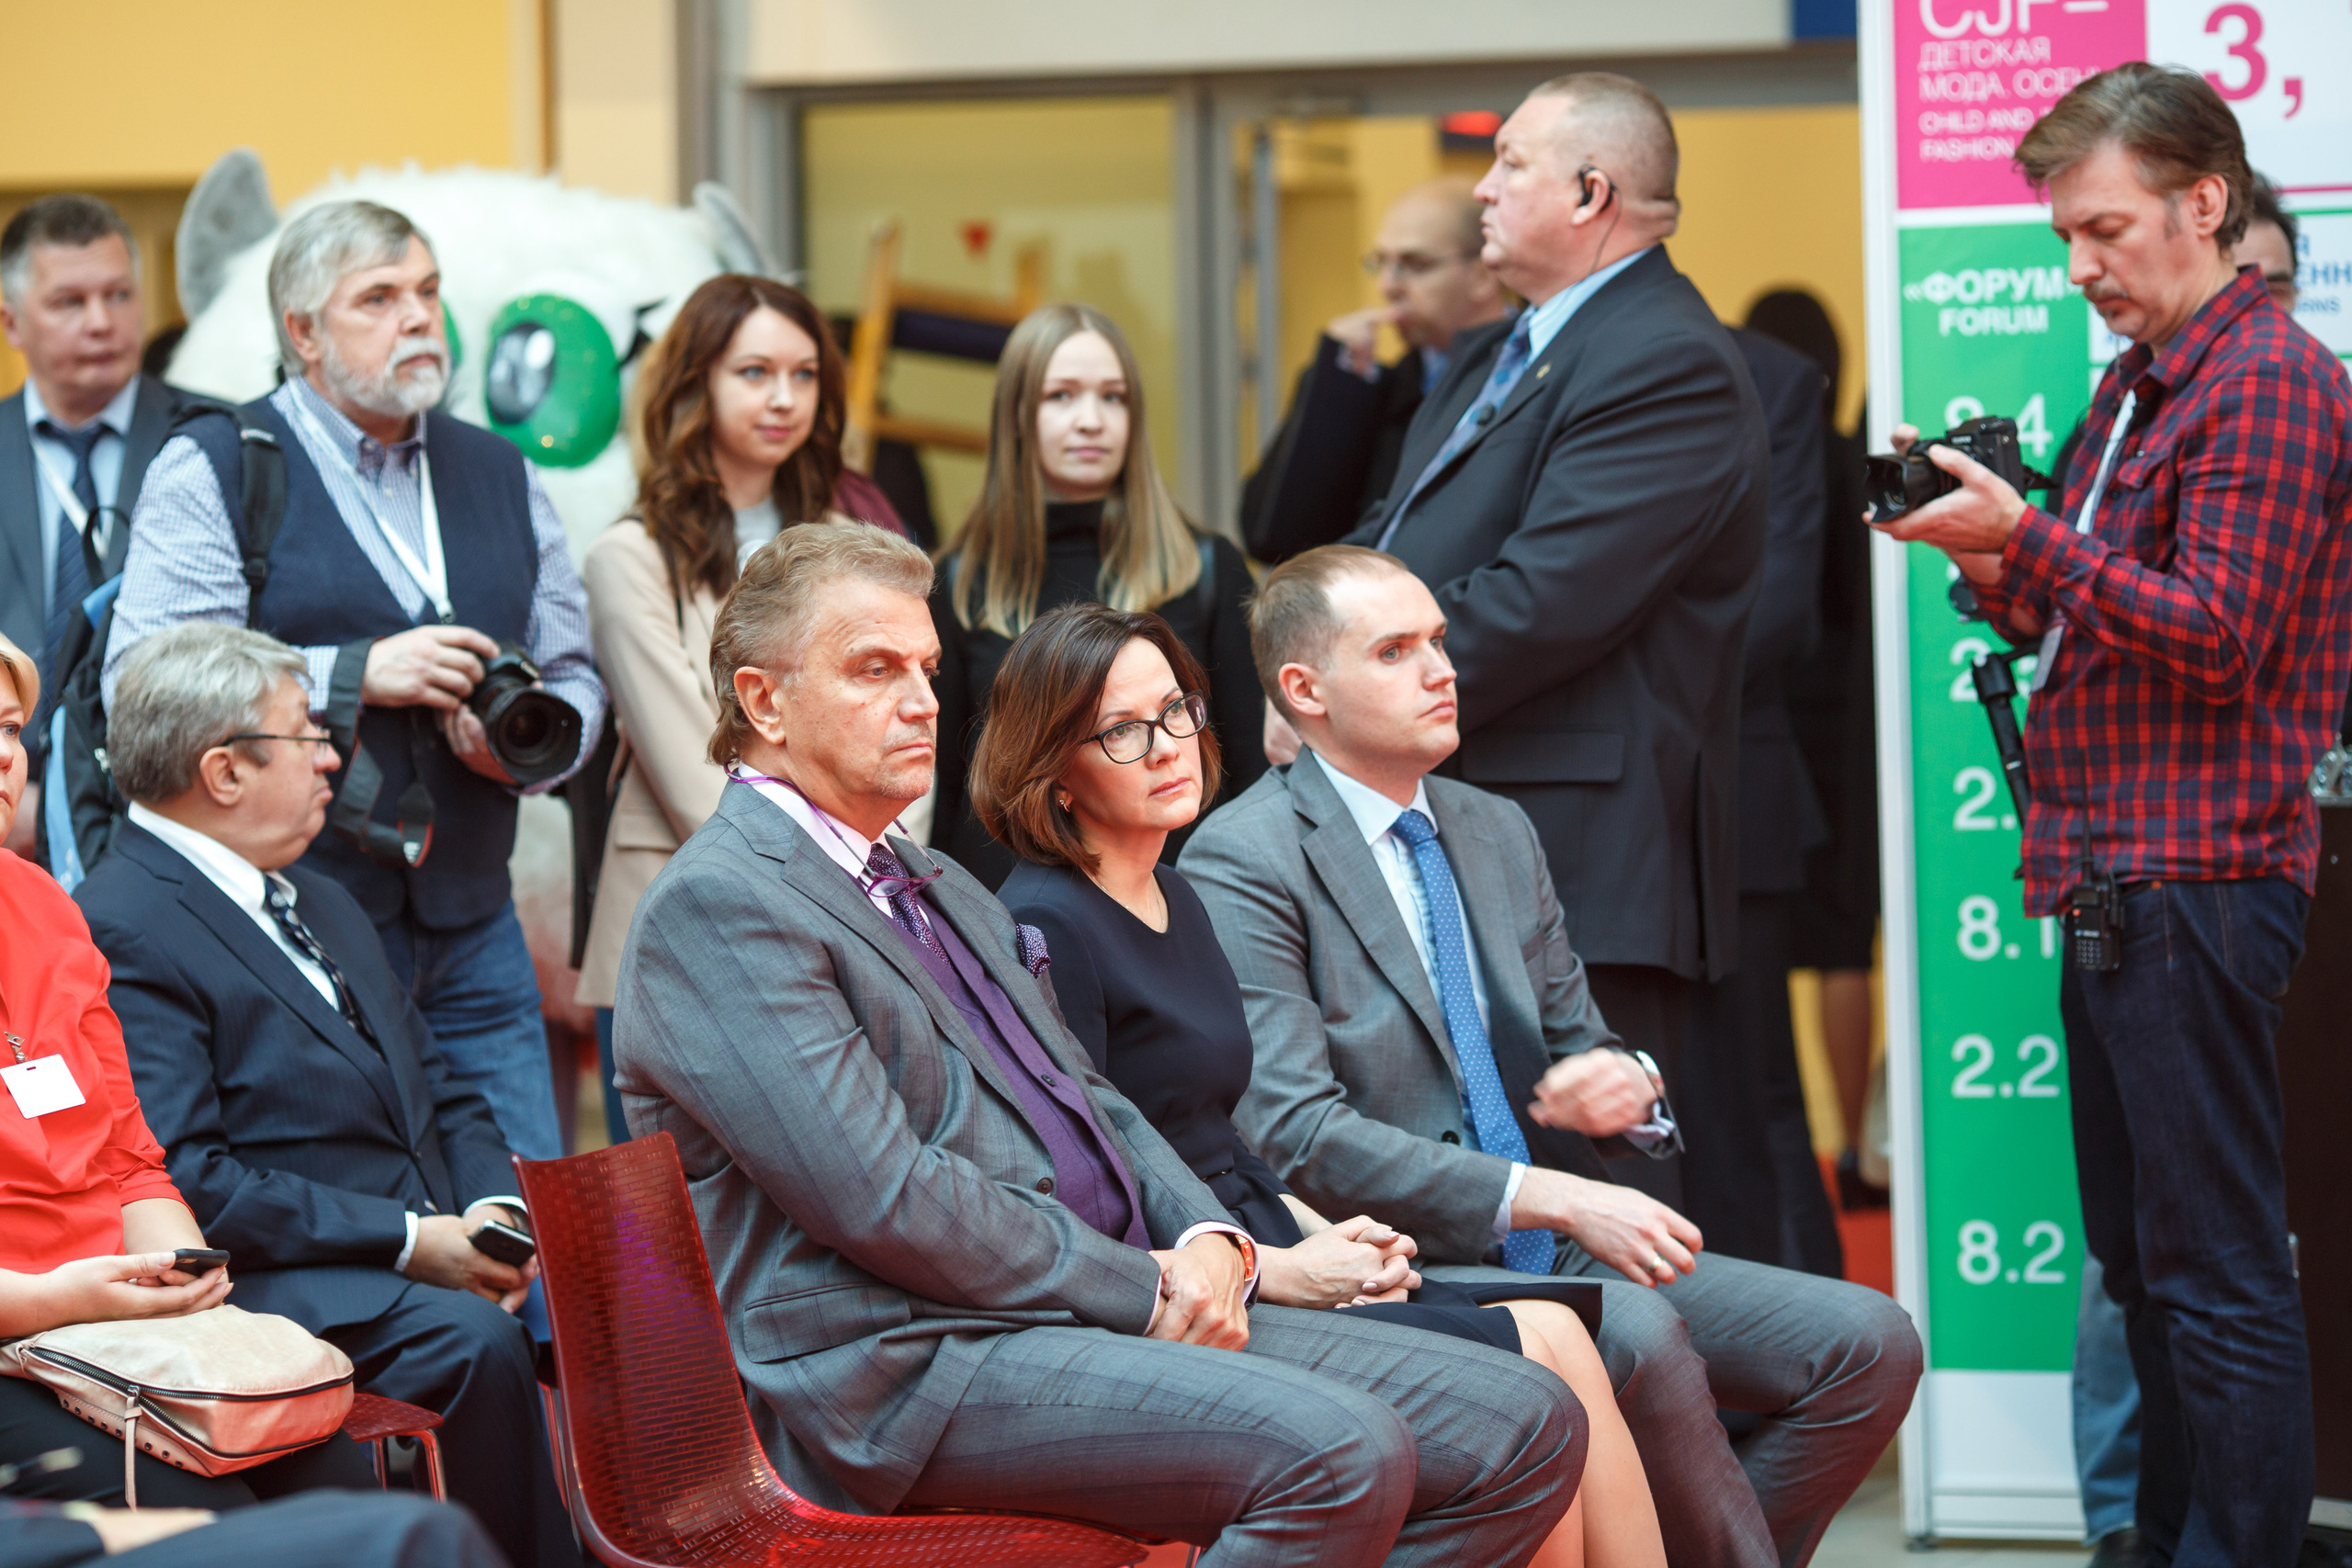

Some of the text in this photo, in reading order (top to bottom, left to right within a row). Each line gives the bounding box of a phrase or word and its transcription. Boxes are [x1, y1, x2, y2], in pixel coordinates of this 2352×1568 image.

[1917, 37, 2051, 72] ДЕТСКАЯ
[1918, 109, 1985, 136] CHILD
[1987, 107, 2034, 131] AND
[1919, 136, 2015, 163] FASHION
[1939, 305, 2049, 336] FORUM
[1951, 1034, 2060, 1098] 2.2
[1957, 1220, 2066, 1284] 8.2
